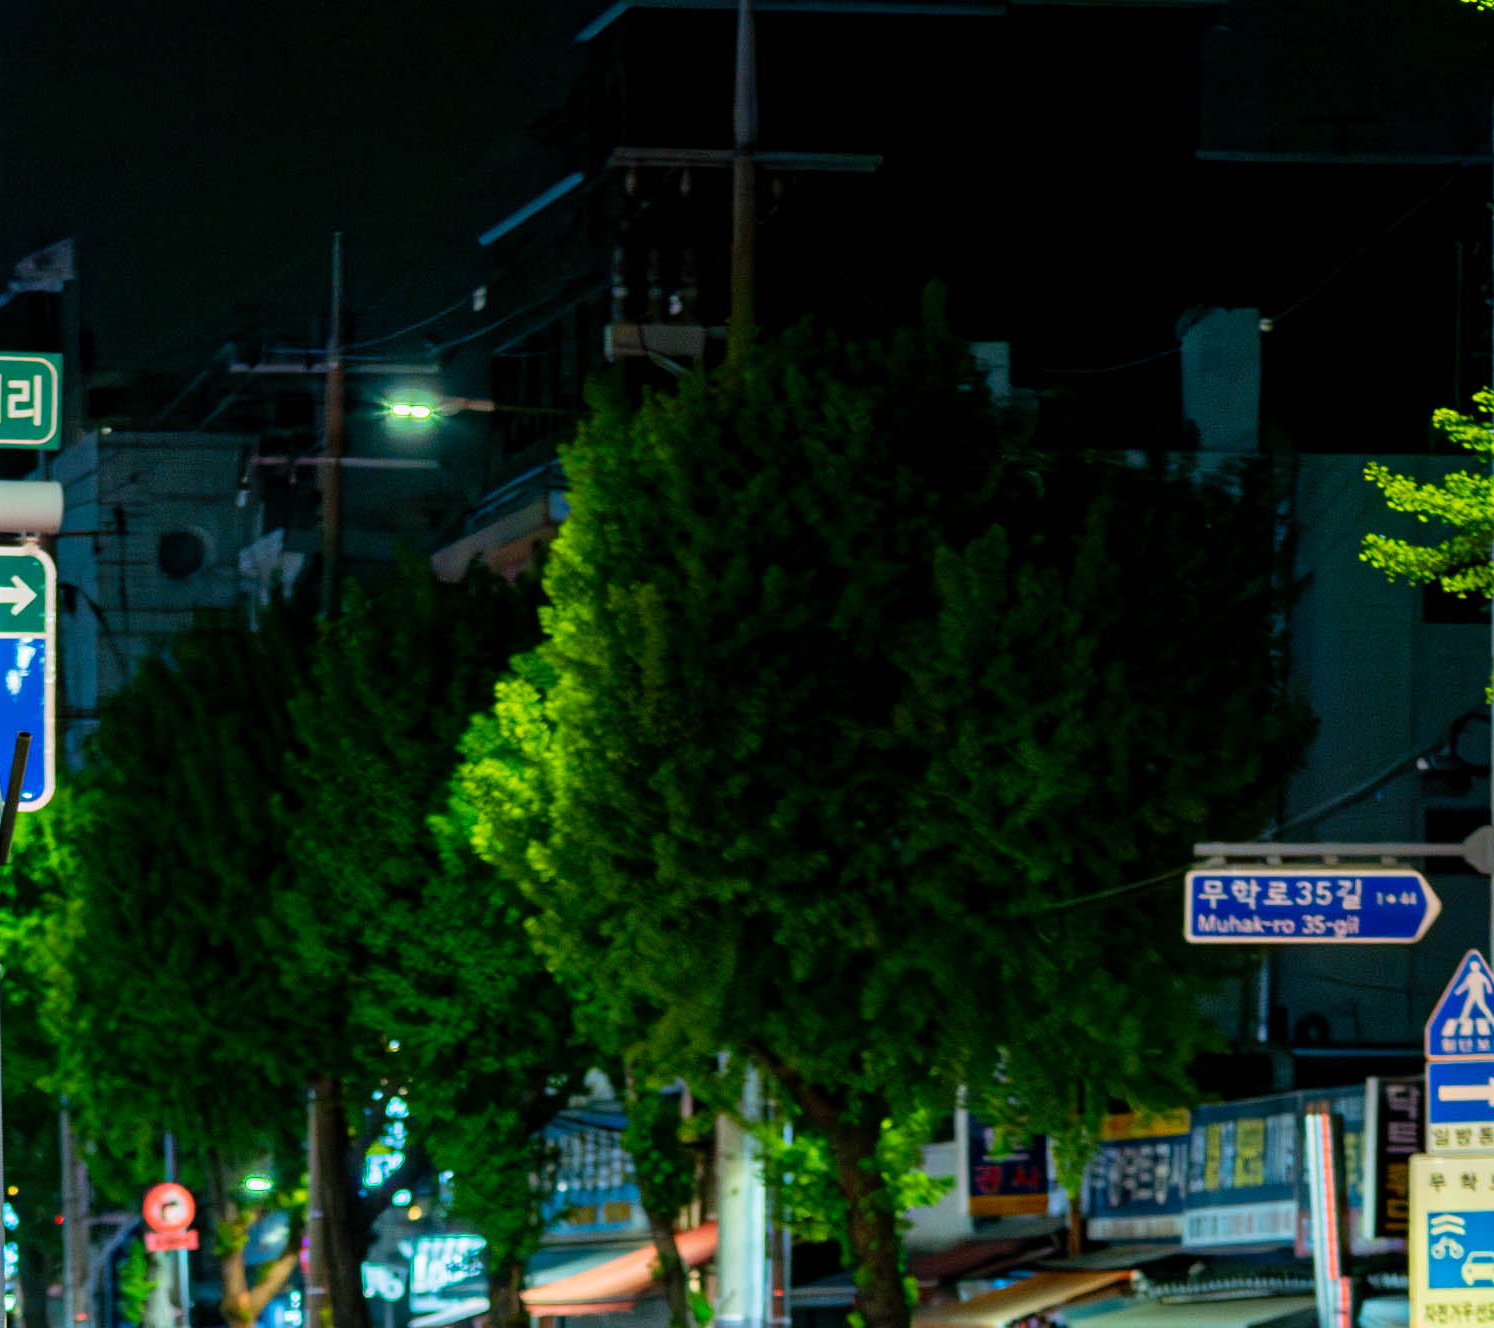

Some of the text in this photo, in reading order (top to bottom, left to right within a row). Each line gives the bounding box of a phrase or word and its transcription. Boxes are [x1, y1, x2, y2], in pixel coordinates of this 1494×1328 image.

[1198, 878, 1362, 910] 무학로35길
[1198, 914, 1360, 938] Muhak-ro 35-gil
